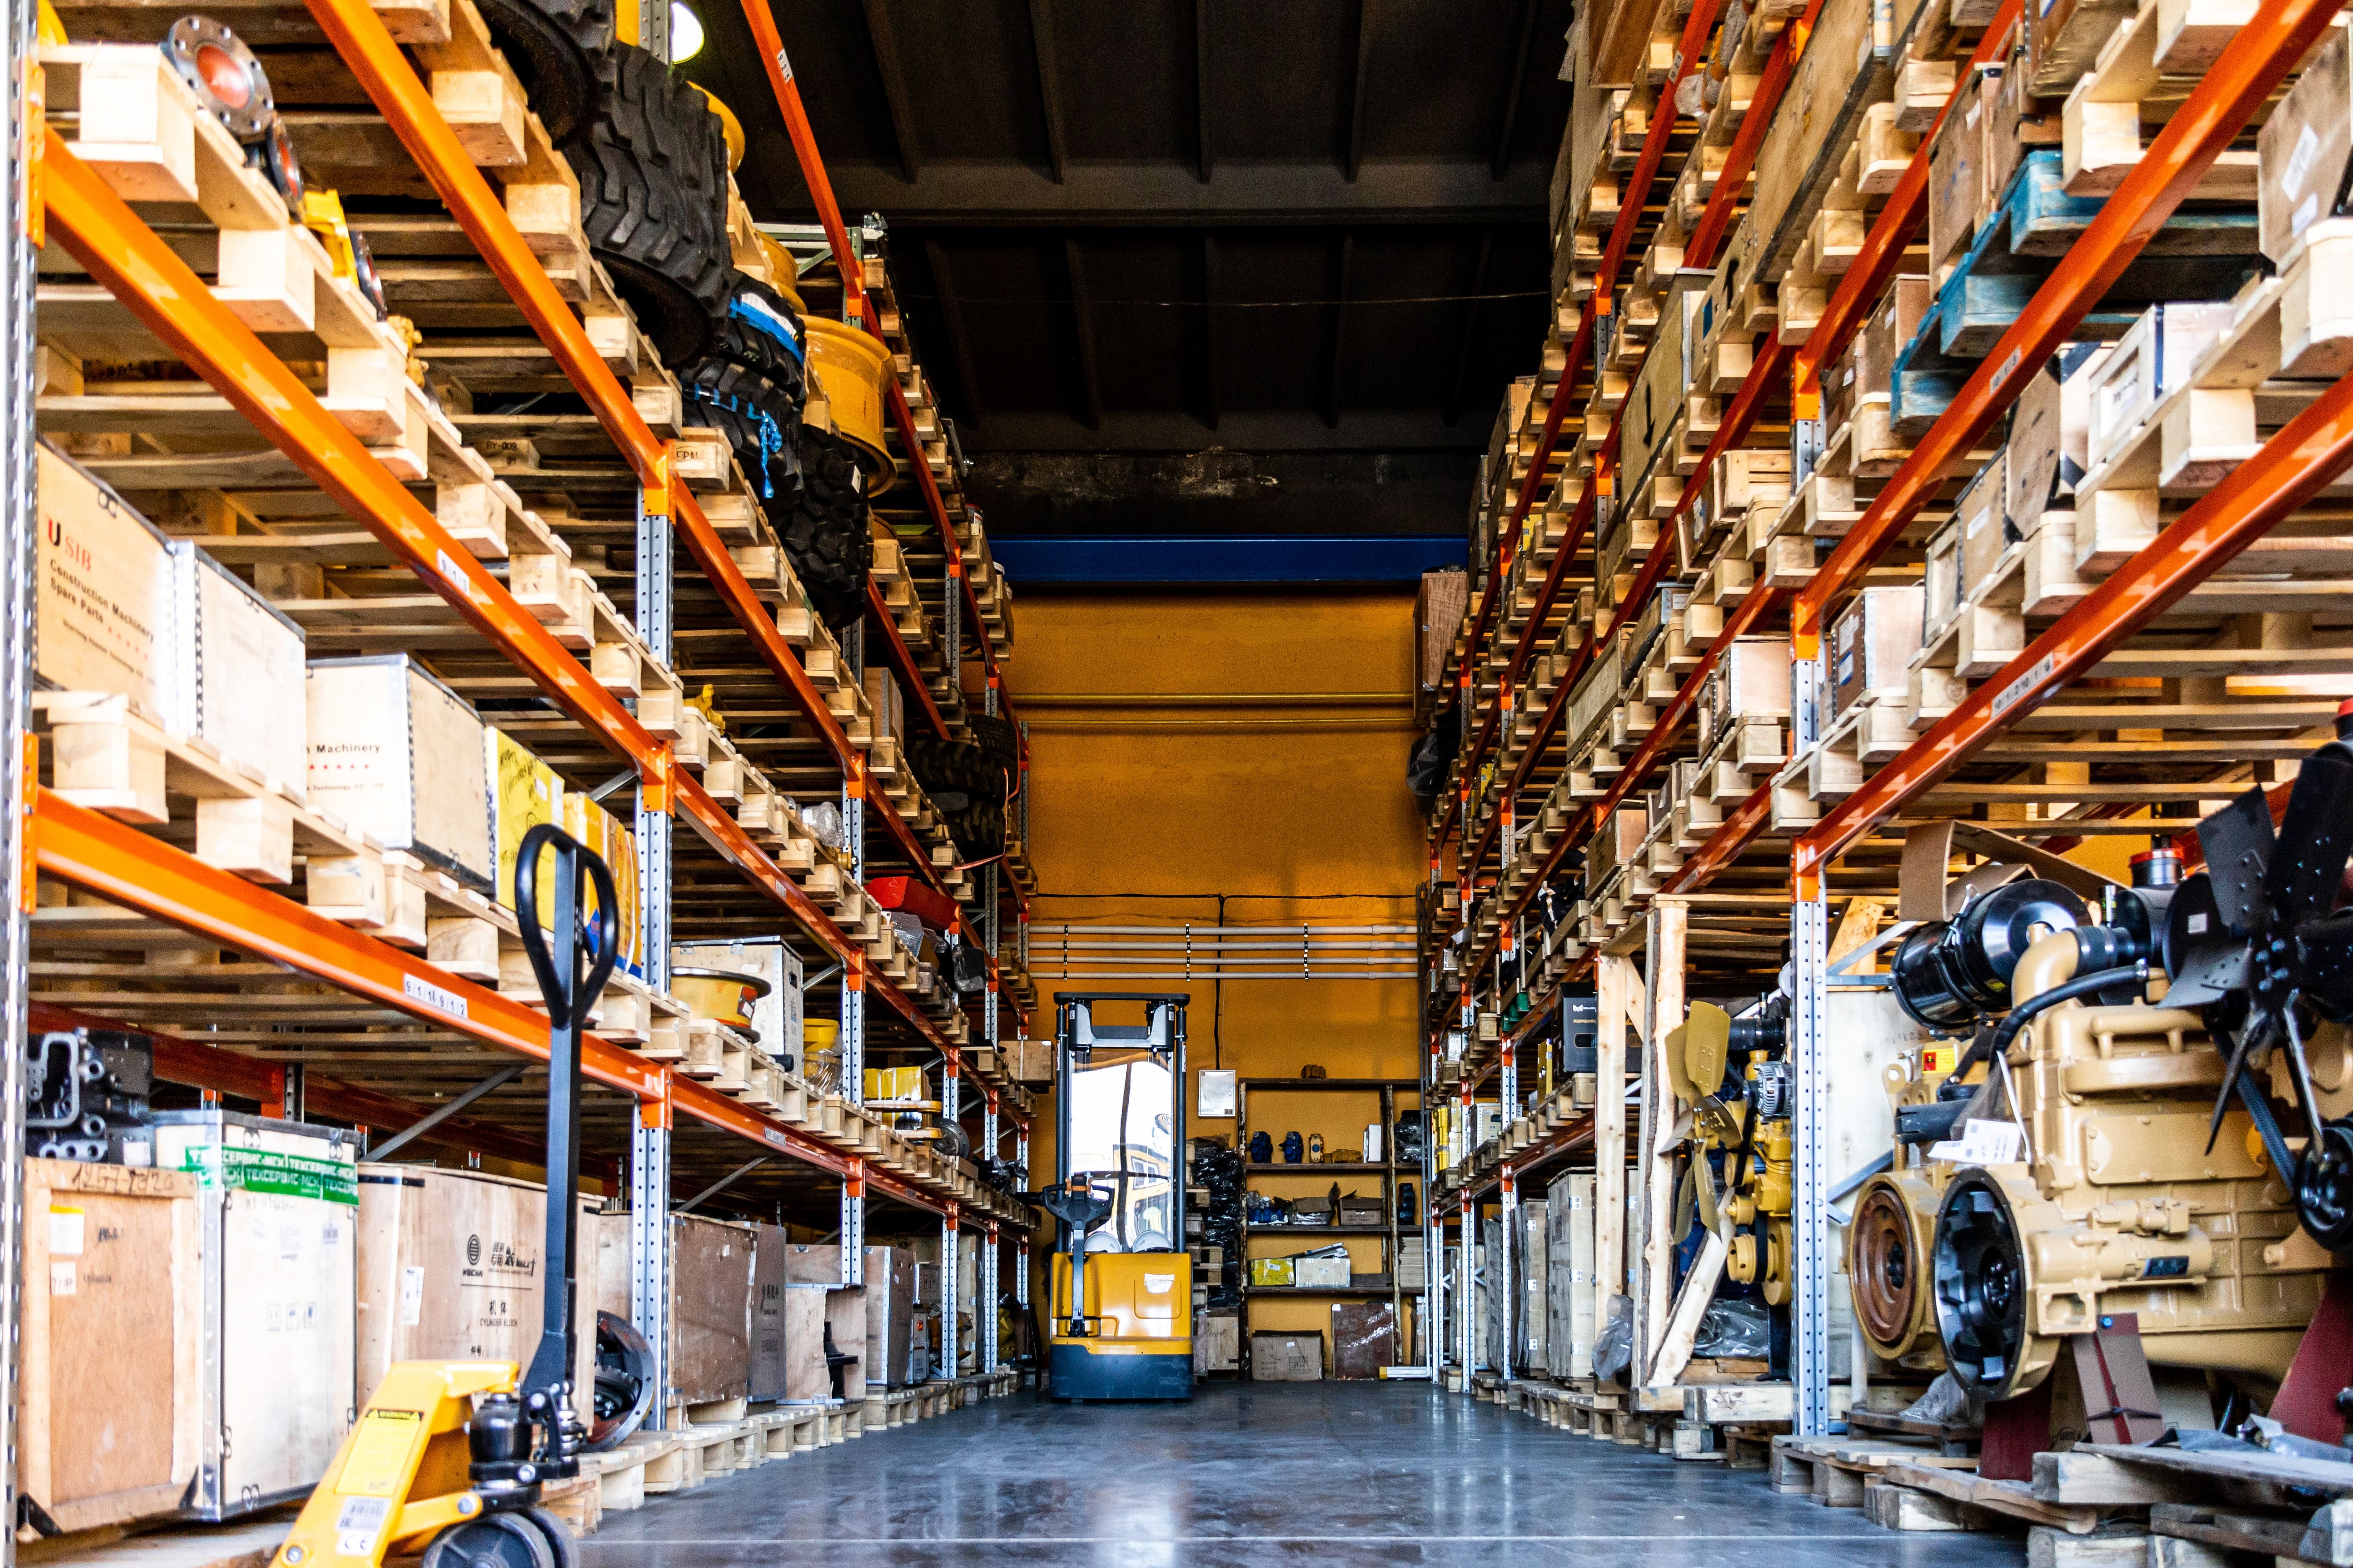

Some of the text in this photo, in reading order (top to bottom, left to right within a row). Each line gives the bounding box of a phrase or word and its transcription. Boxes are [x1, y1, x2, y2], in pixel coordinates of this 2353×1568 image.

[51, 577, 104, 623] Spare Parts
[51, 559, 153, 644] Construction Machinery
[316, 744, 380, 753] Machinery
[480, 1318, 502, 1326] CYLINDER
